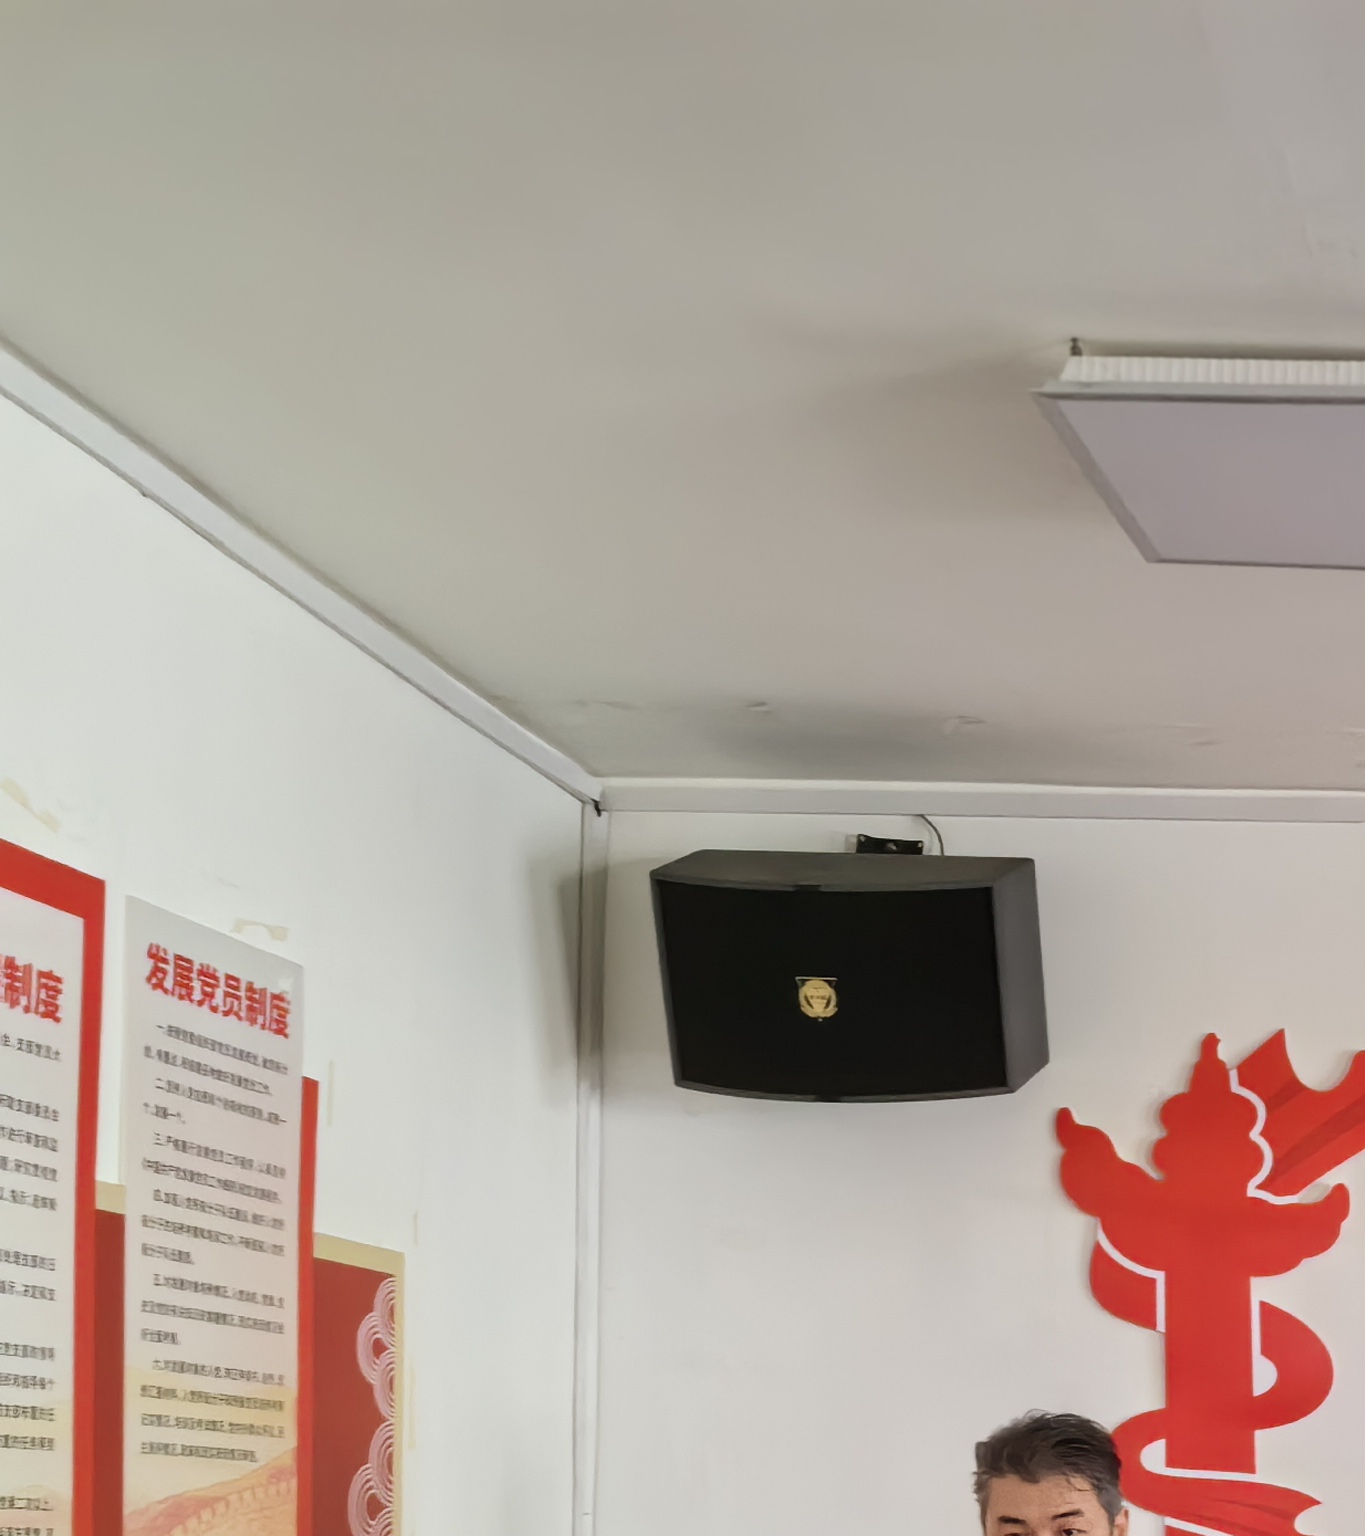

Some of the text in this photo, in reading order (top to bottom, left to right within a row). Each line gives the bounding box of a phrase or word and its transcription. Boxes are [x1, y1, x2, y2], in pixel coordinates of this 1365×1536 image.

[0, 954, 64, 1024] 制度
[146, 942, 291, 1039] 发展党员制度
